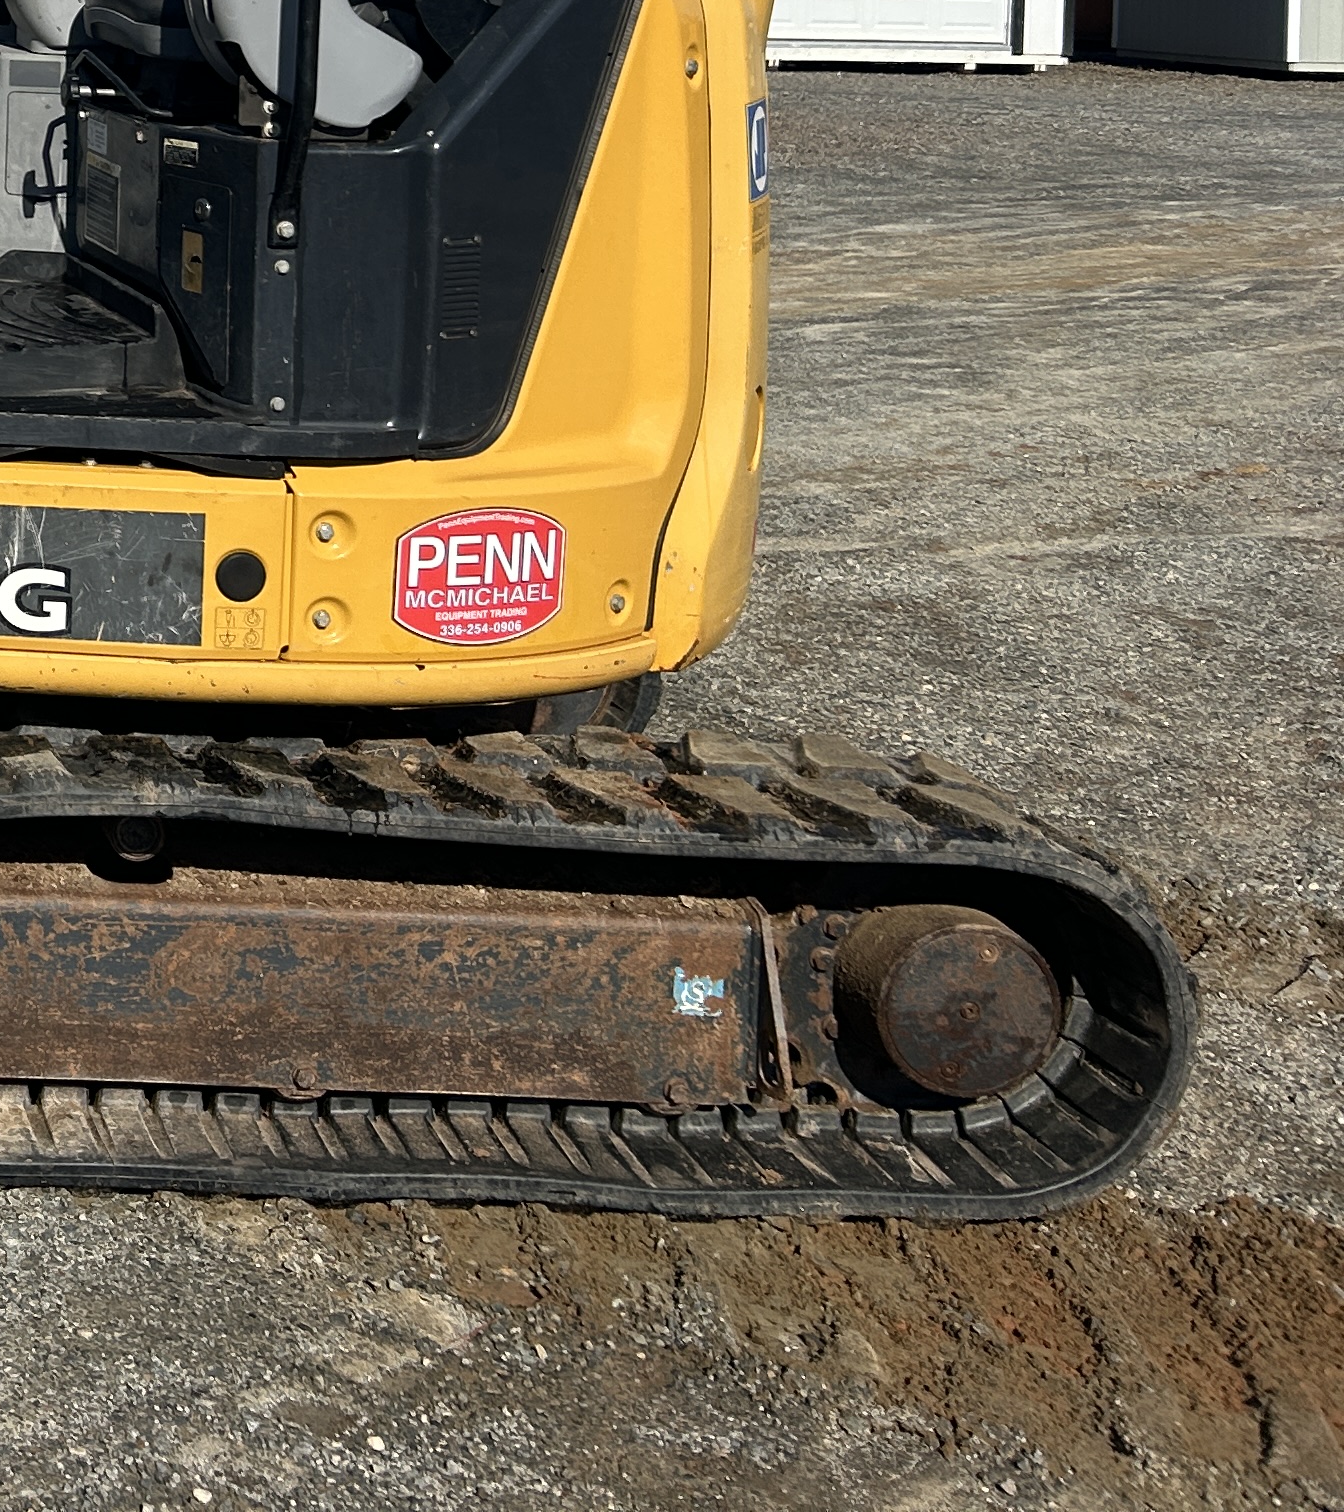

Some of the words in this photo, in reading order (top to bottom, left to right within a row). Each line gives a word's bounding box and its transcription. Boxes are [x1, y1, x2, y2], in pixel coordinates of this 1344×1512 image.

[407, 529, 557, 588] PENN
[404, 583, 554, 608] MCMICHAEL
[435, 609, 488, 622] EQUIPMENT
[490, 606, 528, 618] TRADING
[440, 620, 522, 636] 336-254-0906
